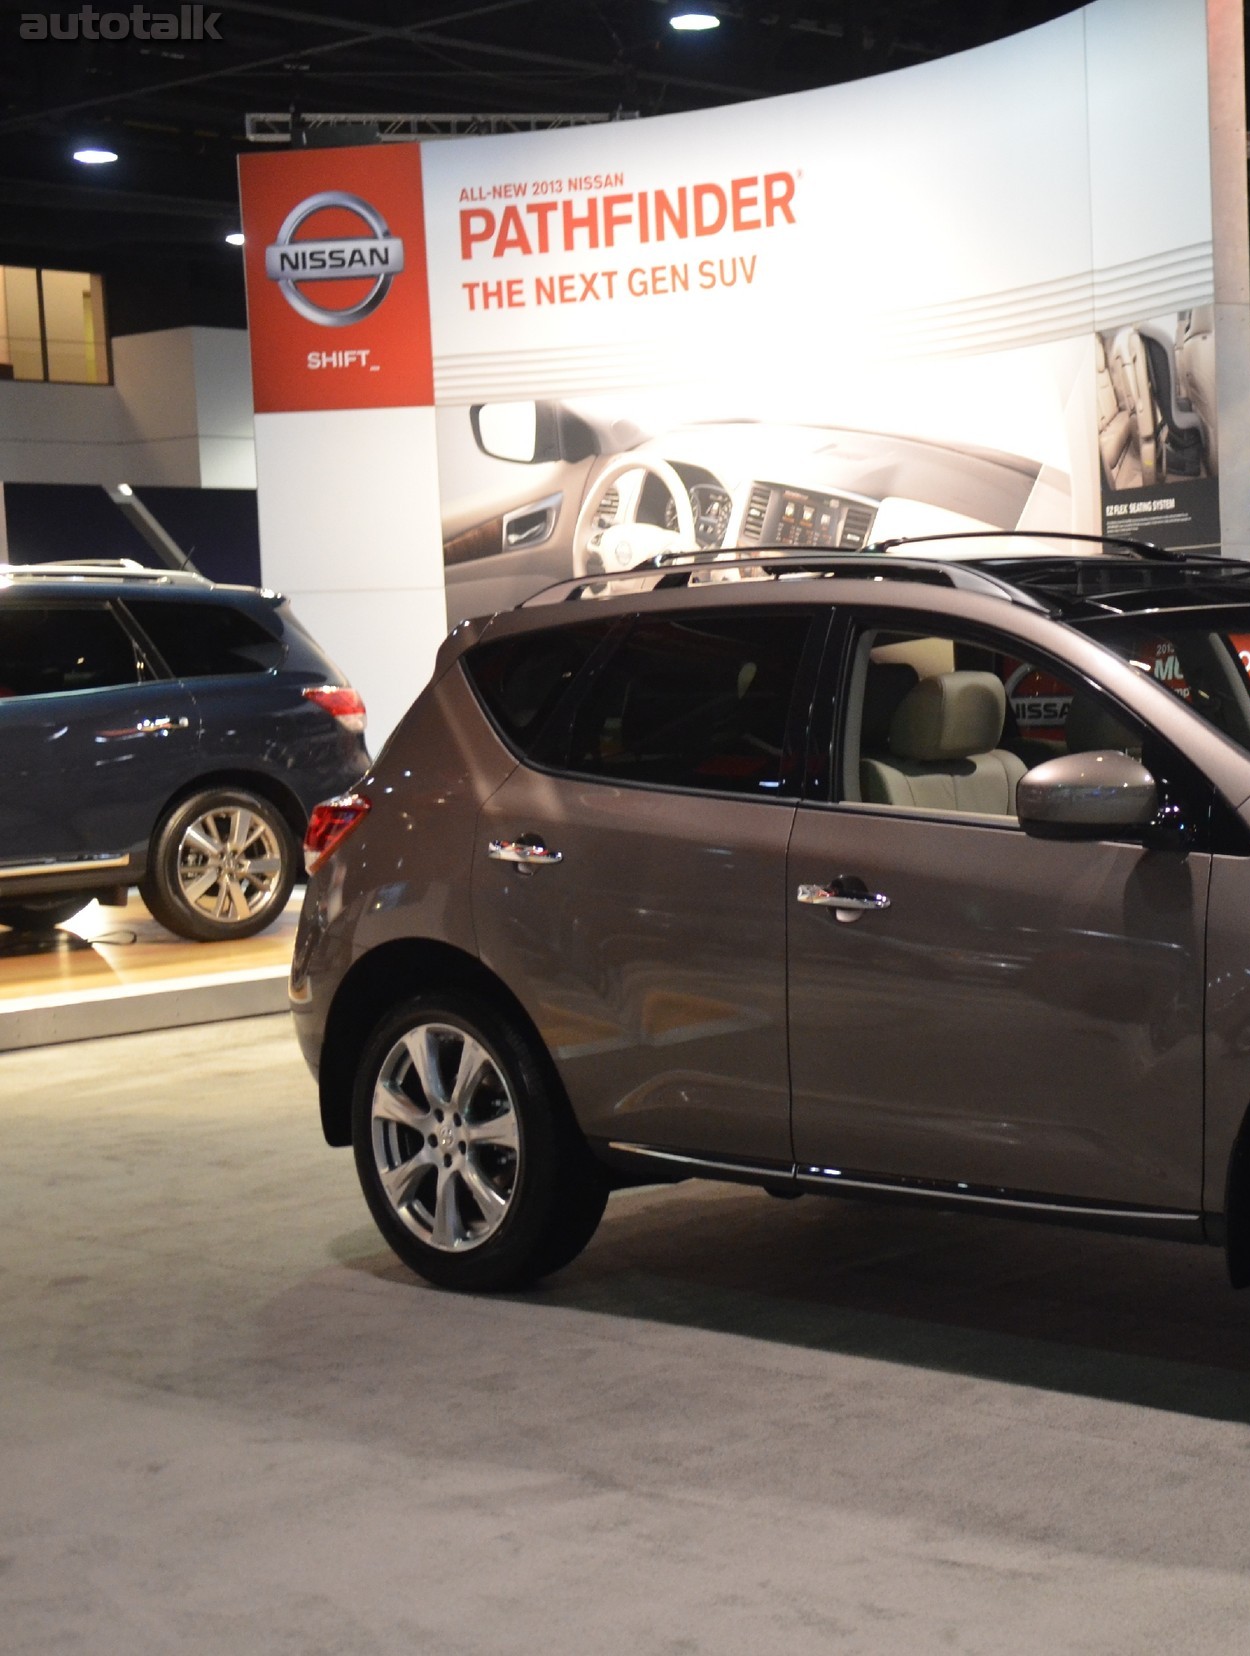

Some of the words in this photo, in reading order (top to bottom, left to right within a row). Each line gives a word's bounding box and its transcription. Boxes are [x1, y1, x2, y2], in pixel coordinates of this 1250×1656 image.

[459, 182, 527, 202] ALL-NEW
[532, 179, 563, 195] 2013
[567, 172, 625, 192] NISSAN
[458, 171, 797, 261] PATHFINDER
[280, 247, 390, 272] NISSAN
[462, 279, 525, 311] THE
[534, 271, 619, 306] NEXT
[627, 263, 690, 297] GEN
[698, 255, 758, 290] SUV
[1129, 501, 1152, 514] SEATING
[1152, 498, 1175, 512] SYSTEM
